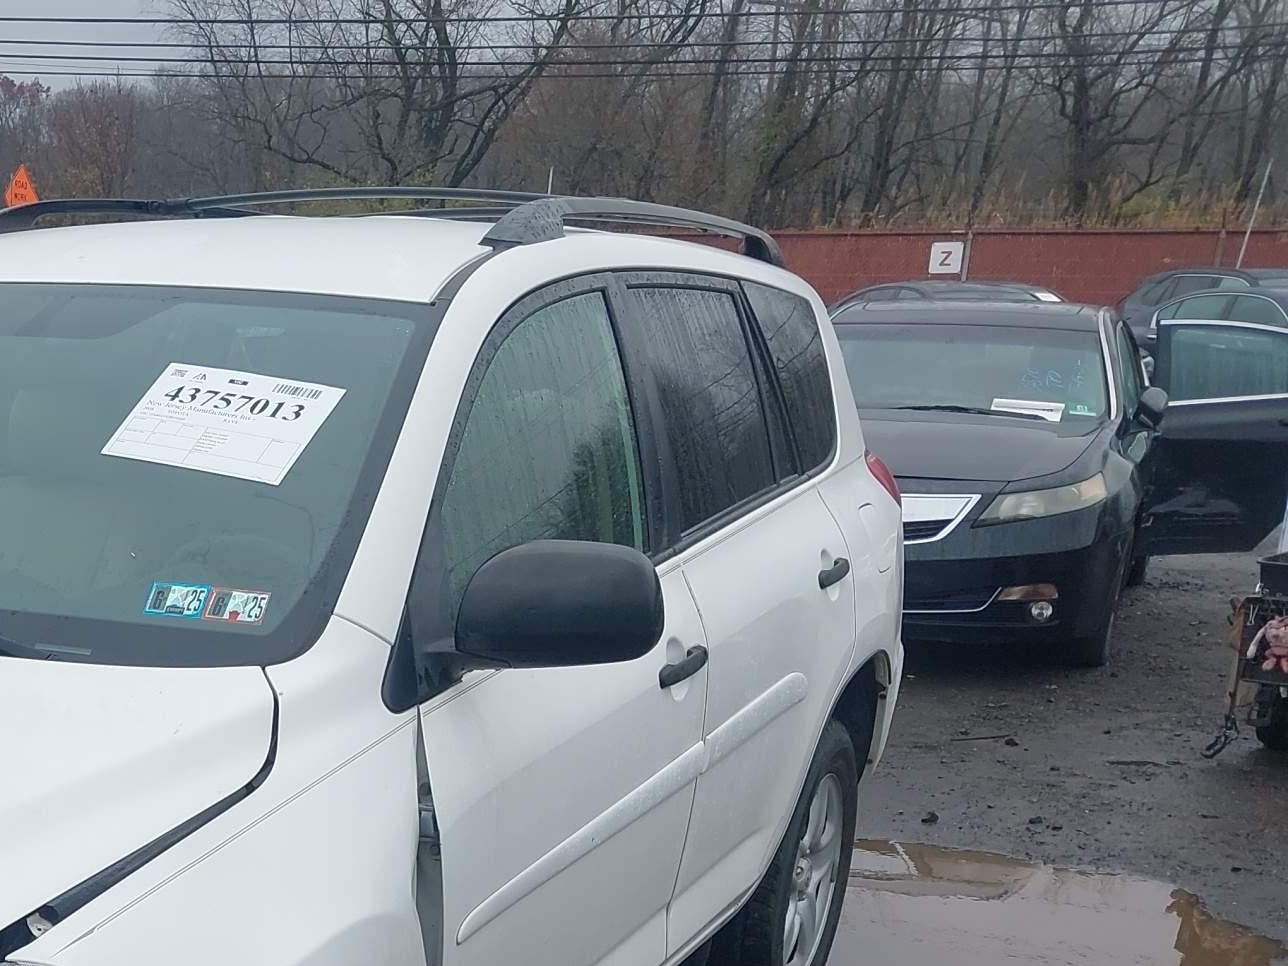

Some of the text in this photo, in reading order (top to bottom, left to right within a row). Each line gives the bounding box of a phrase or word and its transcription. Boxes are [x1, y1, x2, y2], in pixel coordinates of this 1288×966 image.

[939, 251, 953, 267] Z
[164, 385, 305, 422] 43757013
[187, 590, 205, 611] 25
[247, 596, 266, 619] 25
